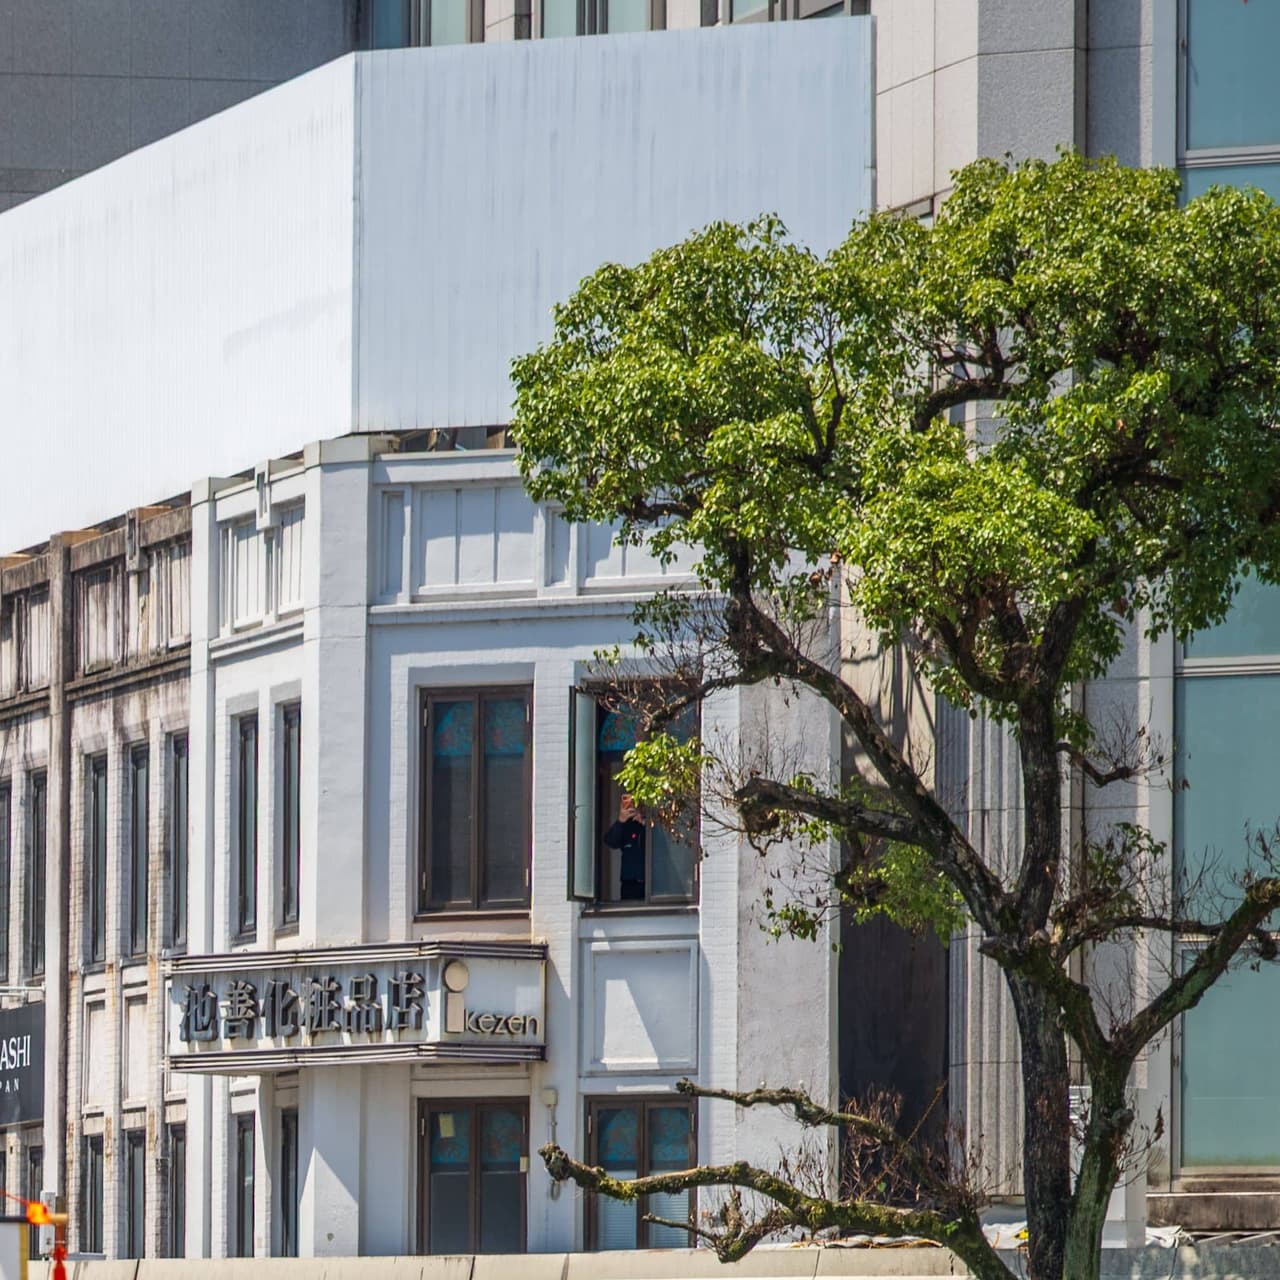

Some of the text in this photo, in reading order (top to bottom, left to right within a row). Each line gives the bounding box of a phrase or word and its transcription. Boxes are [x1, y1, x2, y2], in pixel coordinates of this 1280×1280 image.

[179, 971, 427, 1042] 池善化粧品店
